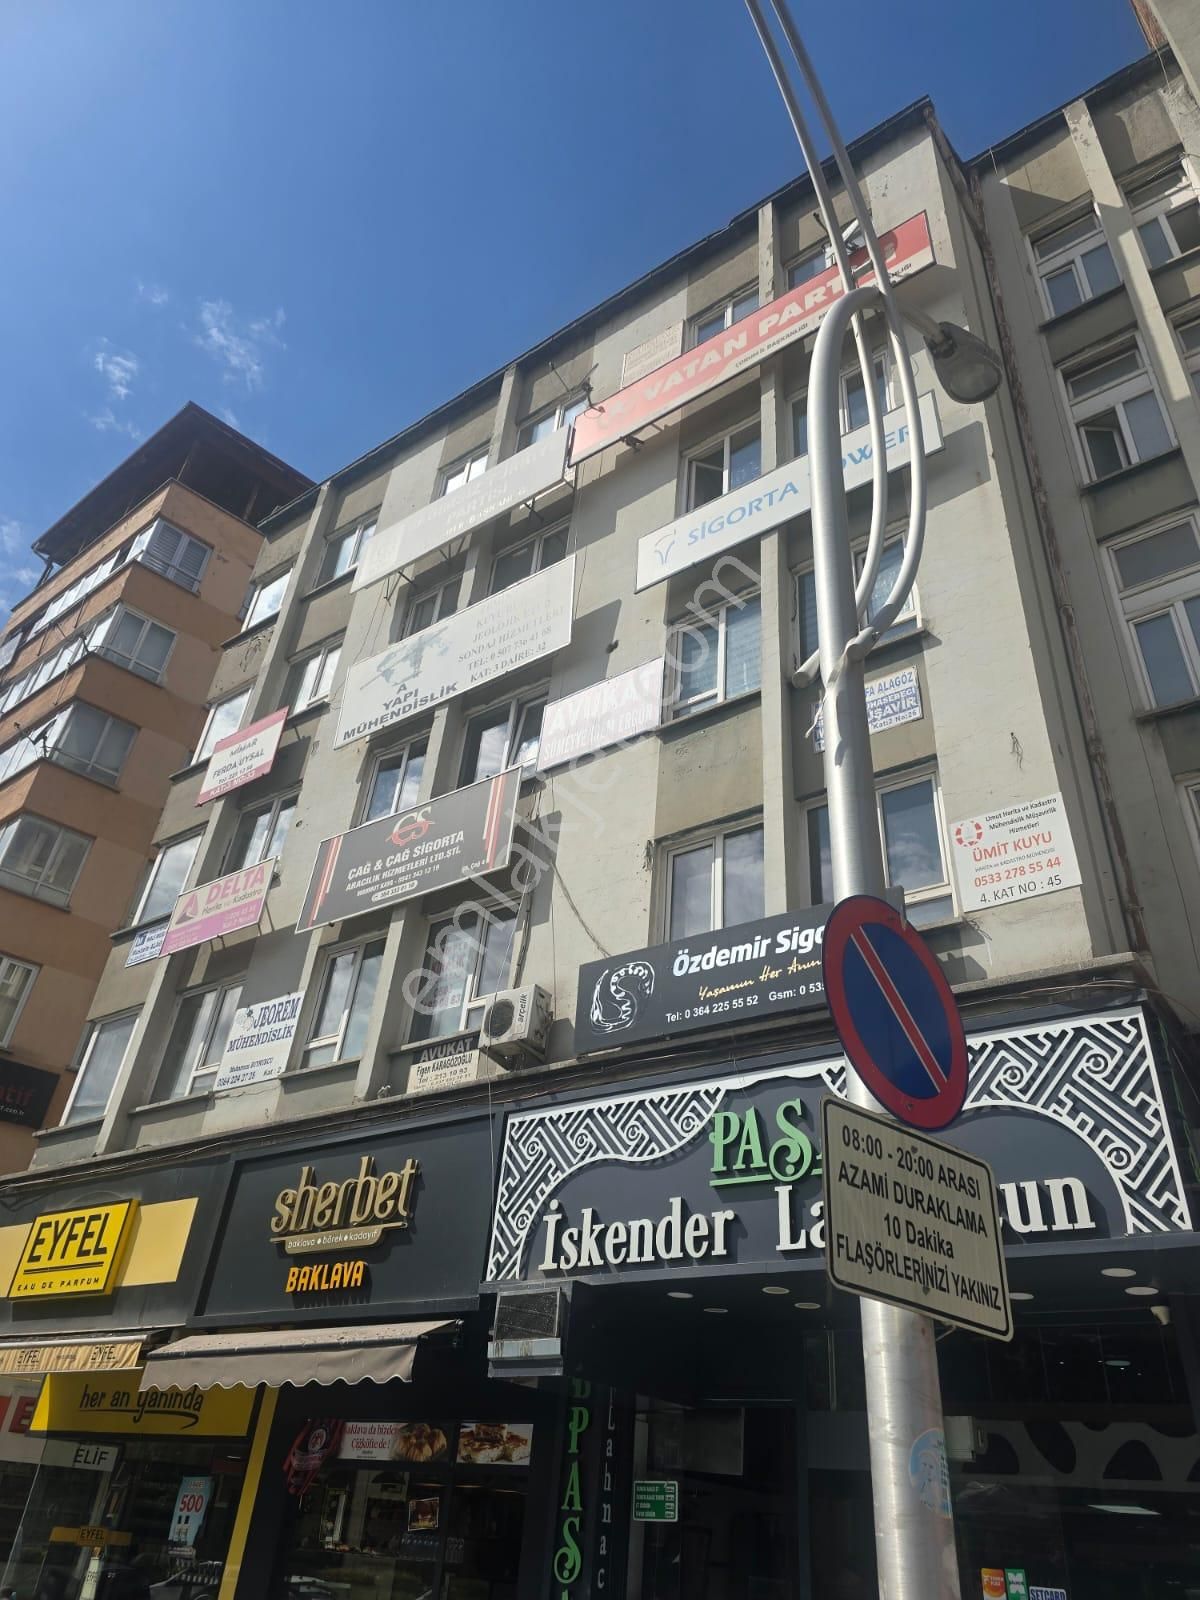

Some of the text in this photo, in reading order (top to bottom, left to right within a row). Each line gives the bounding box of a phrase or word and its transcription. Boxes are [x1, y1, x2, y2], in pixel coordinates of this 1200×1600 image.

[644, 332, 749, 400] VATAN
[458, 640, 496, 663] SONDAJ
[877, 671, 914, 693] ALAGÖZ
[343, 680, 459, 741] MÜHENDİSLİK
[383, 687, 419, 711] YAPI
[212, 749, 265, 780] FERDA UYSAL
[989, 806, 1057, 832] Mühendislik Müşavirlik
[1003, 807, 1021, 819] Harita
[1030, 797, 1057, 810] Kadastro
[1008, 821, 1040, 834] Hizmetleri
[347, 830, 464, 881] ÇAĞ & ÇAĞ SİGORTA
[972, 831, 1053, 862] ÜMİT KUYU
[205, 864, 265, 906] DELTA
[345, 869, 380, 892] ARACILIK
[382, 856, 428, 880] HİZMETLERİ
[974, 856, 1062, 888] 0533 278 55 44
[980, 892, 991, 904] 4.
[993, 885, 1015, 901] KAT
[1018, 880, 1037, 894] NO
[1046, 874, 1062, 888] 45
[671, 935, 772, 977] Özdemir
[759, 963, 781, 983] Her
[253, 996, 302, 1030] JEOREM
[517, 993, 528, 1022] arçelik
[665, 1012, 683, 1025] Tel:
[684, 1009, 692, 1021] 0
[692, 1005, 710, 1018] 364
[712, 1001, 731, 1014] 225
[731, 998, 745, 1010] 55
[745, 994, 759, 1007] 52
[768, 987, 797, 1002] Gsm:
[799, 985, 807, 996] 0
[227, 1024, 294, 1053] MÜHENDİSLİK
[419, 1037, 474, 1063] AVUKAT
[416, 1065, 431, 1078] Figen
[841, 1123, 883, 1161] 08:00
[896, 1146, 935, 1182] 20:00
[938, 1165, 982, 1201] ARASI
[271, 1155, 418, 1233] sherbet
[838, 1160, 989, 1238] AZAMİ DURAKLAMA
[27, 1212, 111, 1264] EYFEL
[287, 1229, 378, 1249] baklava börek kadayıf
[536, 1195, 735, 1272] İskender
[884, 1211, 955, 1260] 10 Dakika
[17, 1276, 100, 1292] EAU DE PARFUM
[285, 1260, 367, 1293] BAKLAVA
[836, 1232, 1002, 1311] FLAŞÖRLERİNİZİ YAKINIZ
[79, 1384, 205, 1425] her an yanında
[73, 1445, 110, 1466] ELİF
[378, 1437, 387, 1449] de
[179, 1493, 204, 1513] 500
[79, 1528, 105, 1541] EYFEL
